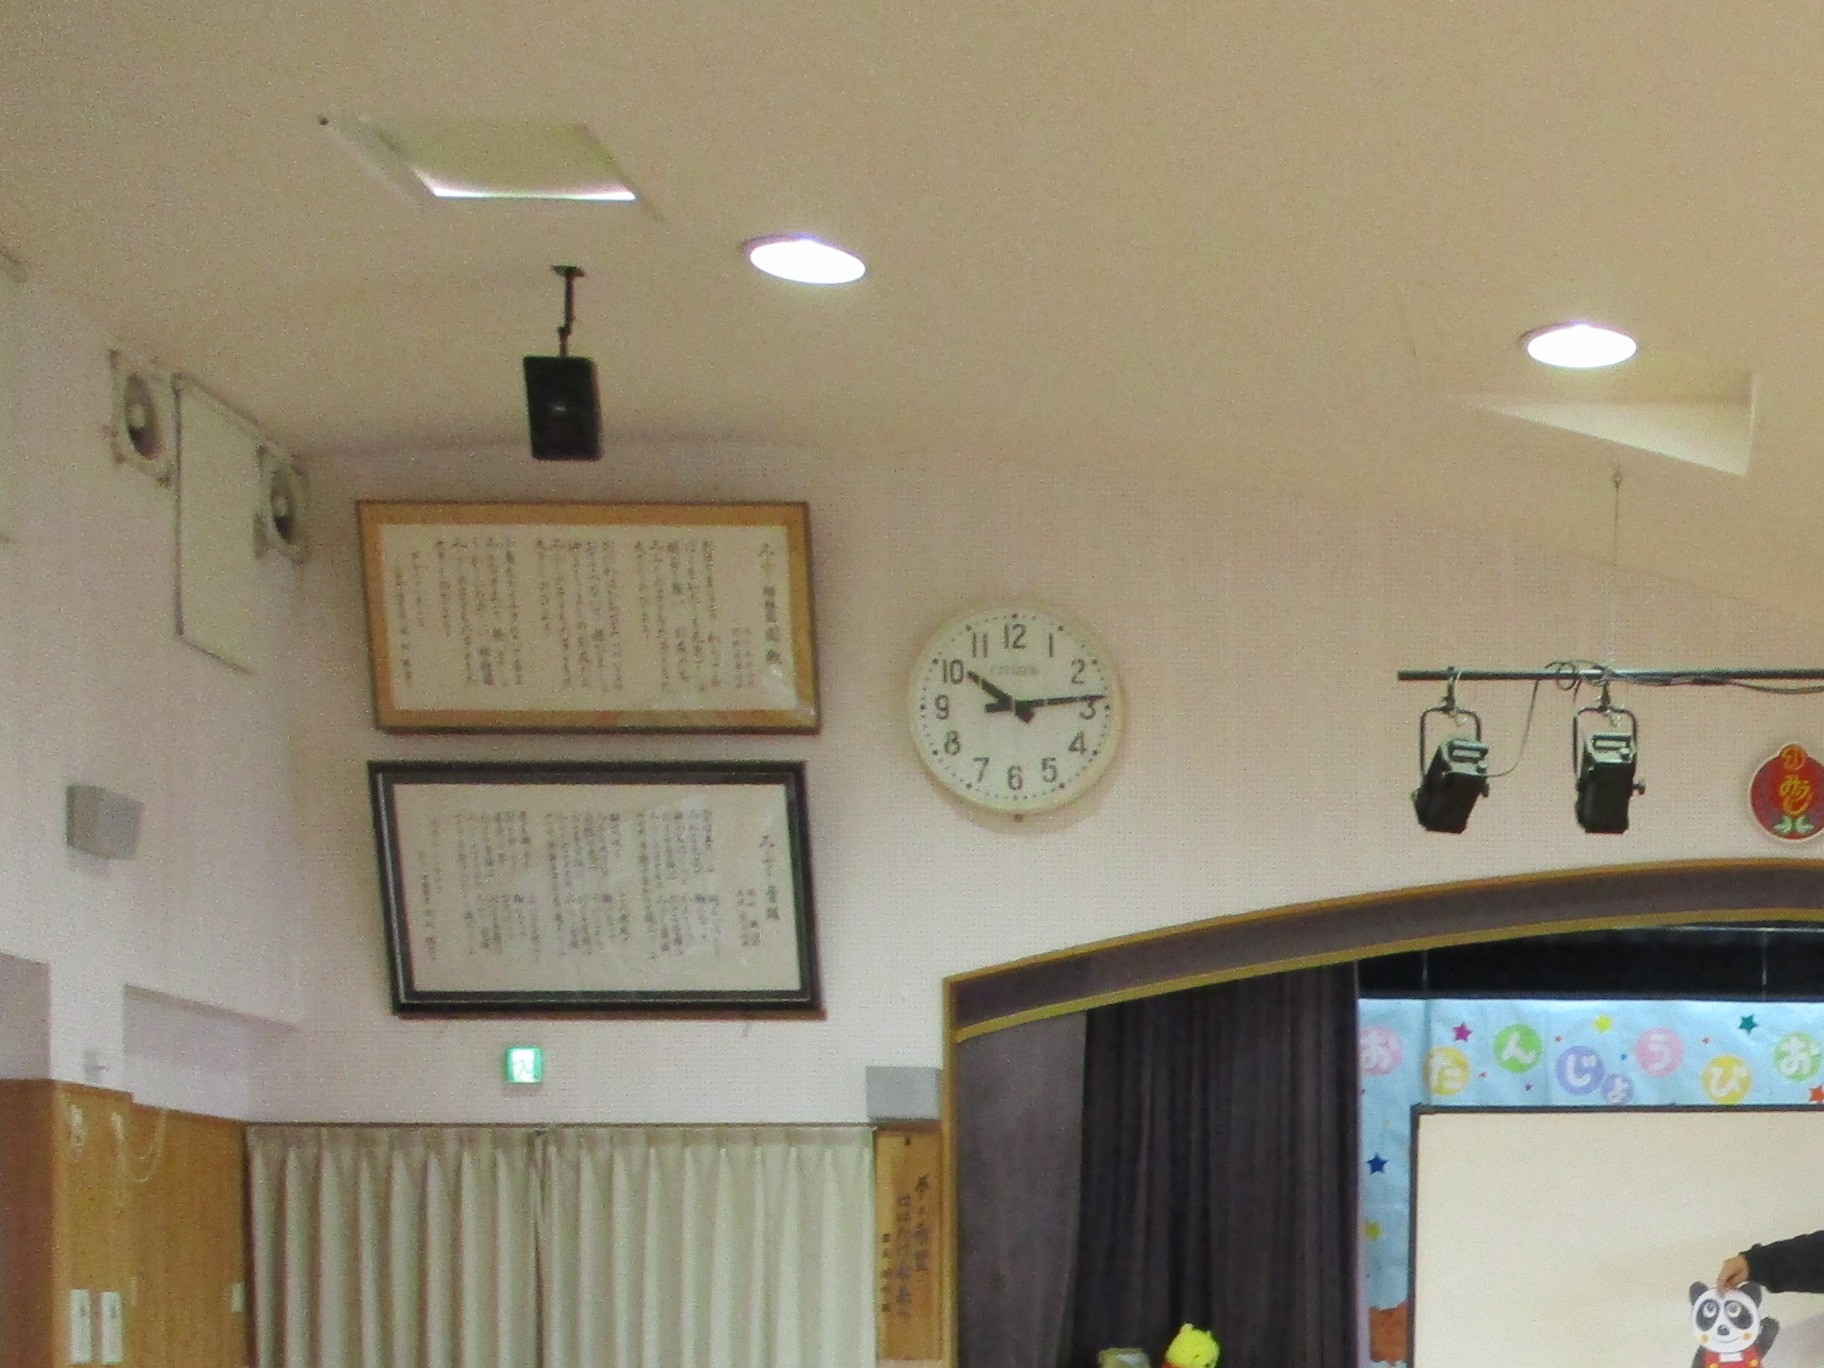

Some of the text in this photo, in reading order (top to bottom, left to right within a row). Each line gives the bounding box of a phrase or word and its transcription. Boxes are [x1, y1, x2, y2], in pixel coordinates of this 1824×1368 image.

[971, 632, 989, 658] 11
[1003, 623, 1027, 649] 12
[1048, 633, 1055, 658] 1
[942, 658, 965, 684] 10
[1070, 658, 1086, 685] 2
[934, 694, 950, 720] 9
[1078, 696, 1097, 720] 3
[944, 730, 961, 755] 8
[1068, 730, 1088, 755] 4
[973, 757, 990, 782] 7
[1007, 765, 1024, 791] 6
[1041, 757, 1058, 782] 5
